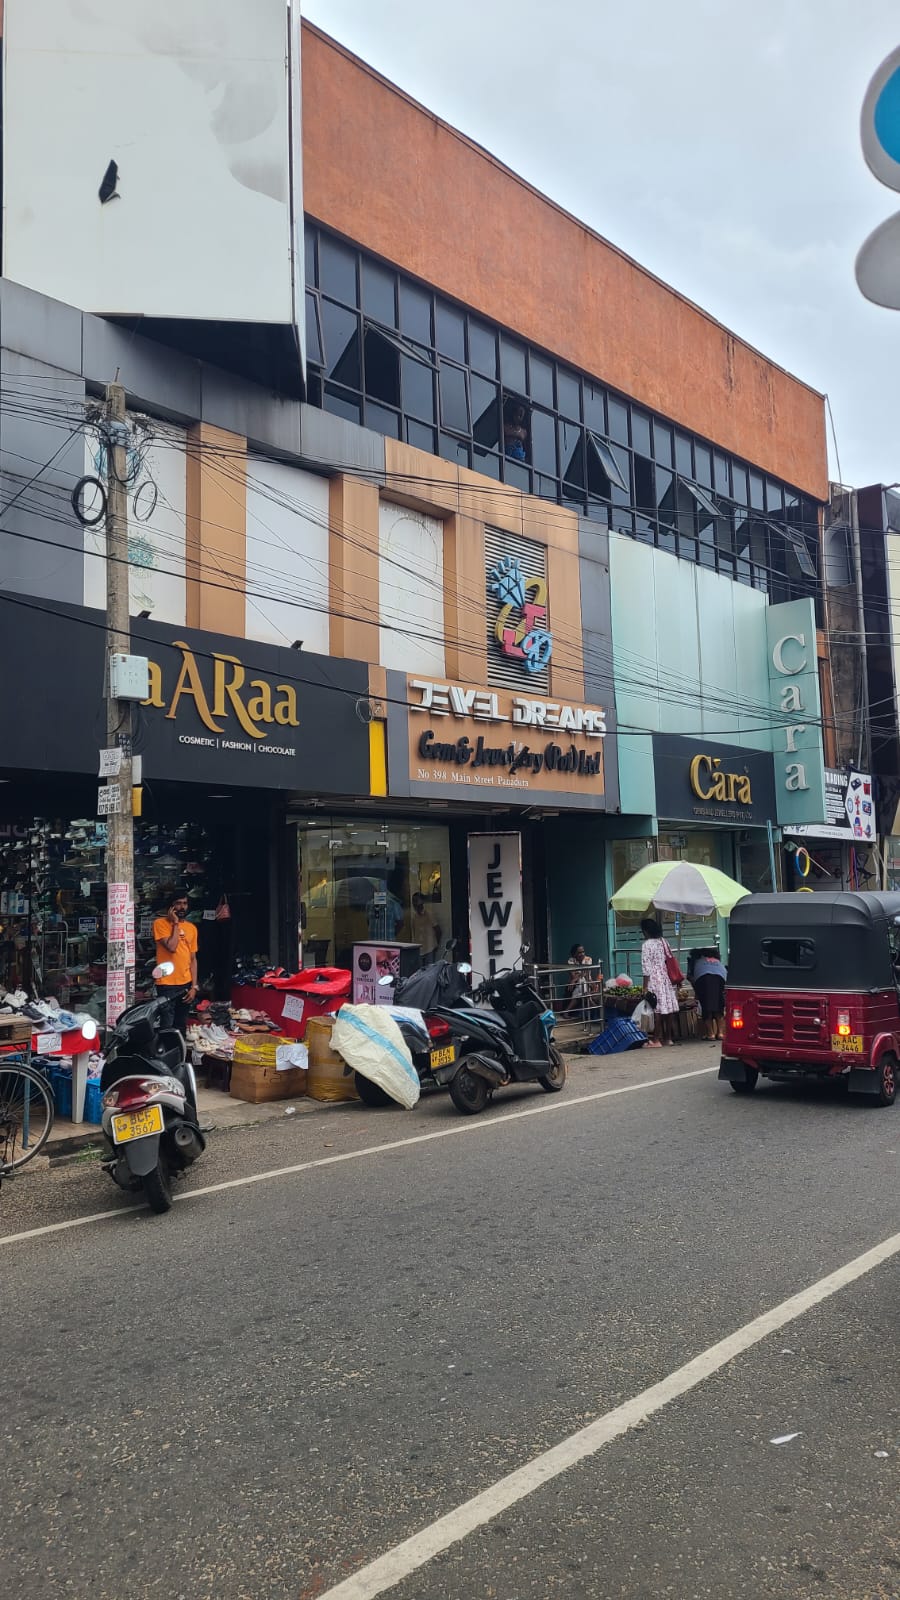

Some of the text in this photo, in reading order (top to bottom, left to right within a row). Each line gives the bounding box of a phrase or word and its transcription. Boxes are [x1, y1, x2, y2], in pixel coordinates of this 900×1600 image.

[409, 679, 607, 738] JEWEL DREAMS
[772, 634, 809, 791] Cara
[178, 735, 296, 756] COSMETIC FASHION CHOCOLATE
[419, 730, 456, 761] Gem
[417, 769, 529, 787] No 398 Main Street Panadura
[689, 754, 753, 805] Cara
[841, 1044, 859, 1052] 3446
[842, 1036, 858, 1044] AAC
[129, 1109, 152, 1125] BCF
[130, 1120, 154, 1137] 3567
